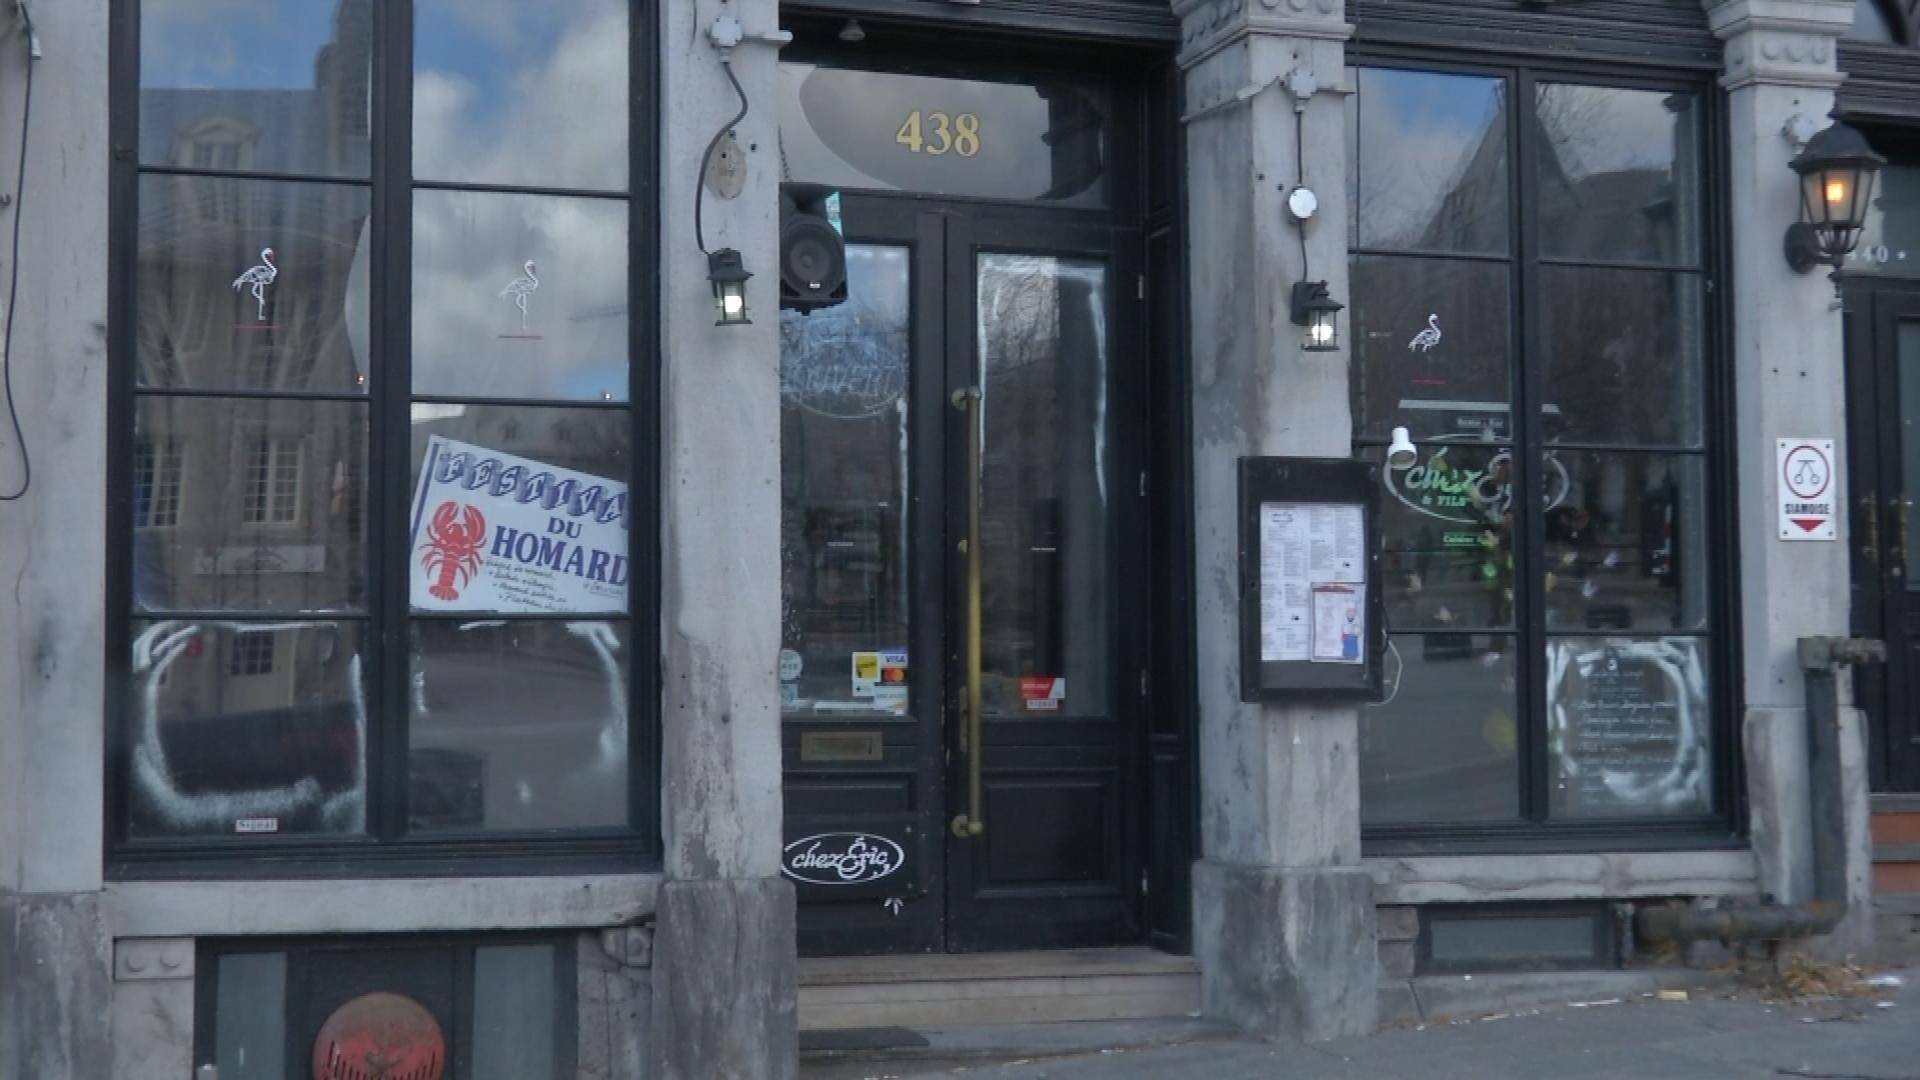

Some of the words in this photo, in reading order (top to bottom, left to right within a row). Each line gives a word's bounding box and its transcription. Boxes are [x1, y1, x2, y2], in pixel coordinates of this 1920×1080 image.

[896, 110, 980, 157] 438
[434, 452, 628, 527] FESTIVA
[1784, 503, 1830, 515] SIAMOISE
[547, 516, 583, 539] DU
[490, 525, 628, 587] HOMARD
